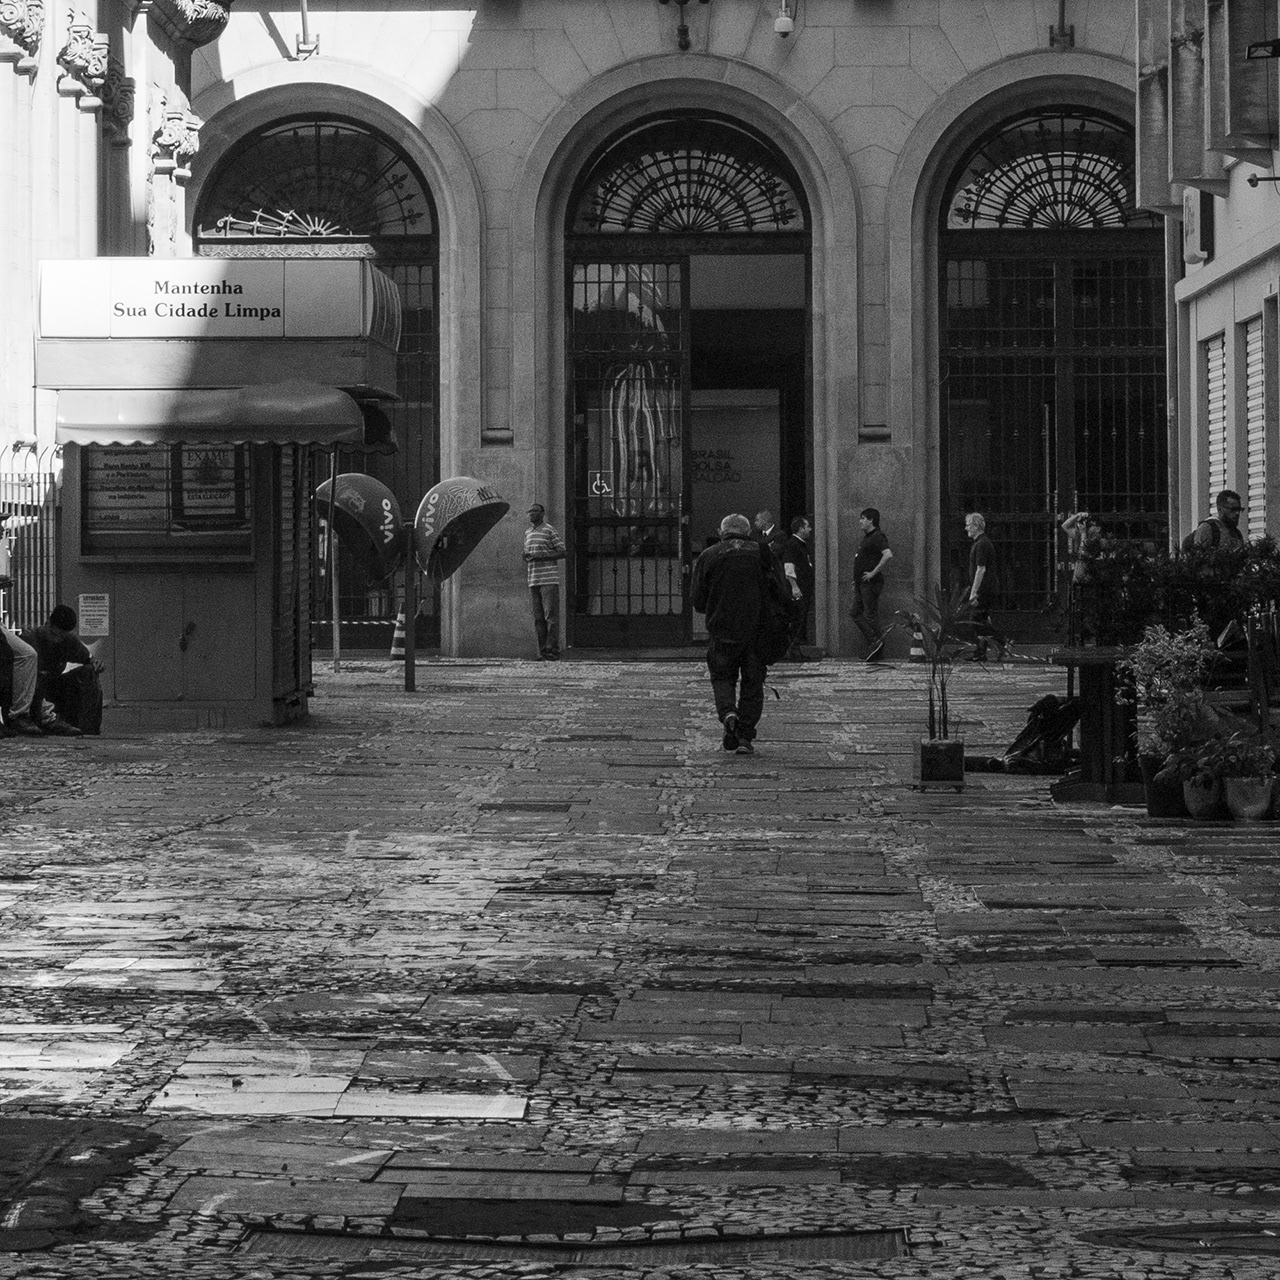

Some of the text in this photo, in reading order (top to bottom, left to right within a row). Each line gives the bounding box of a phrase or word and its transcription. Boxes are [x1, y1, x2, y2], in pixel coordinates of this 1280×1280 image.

[154, 280, 243, 295] Mantenha
[113, 302, 281, 321] Sua Cidade Limpa
[379, 499, 394, 544] vivo
[422, 493, 439, 537] vivo
